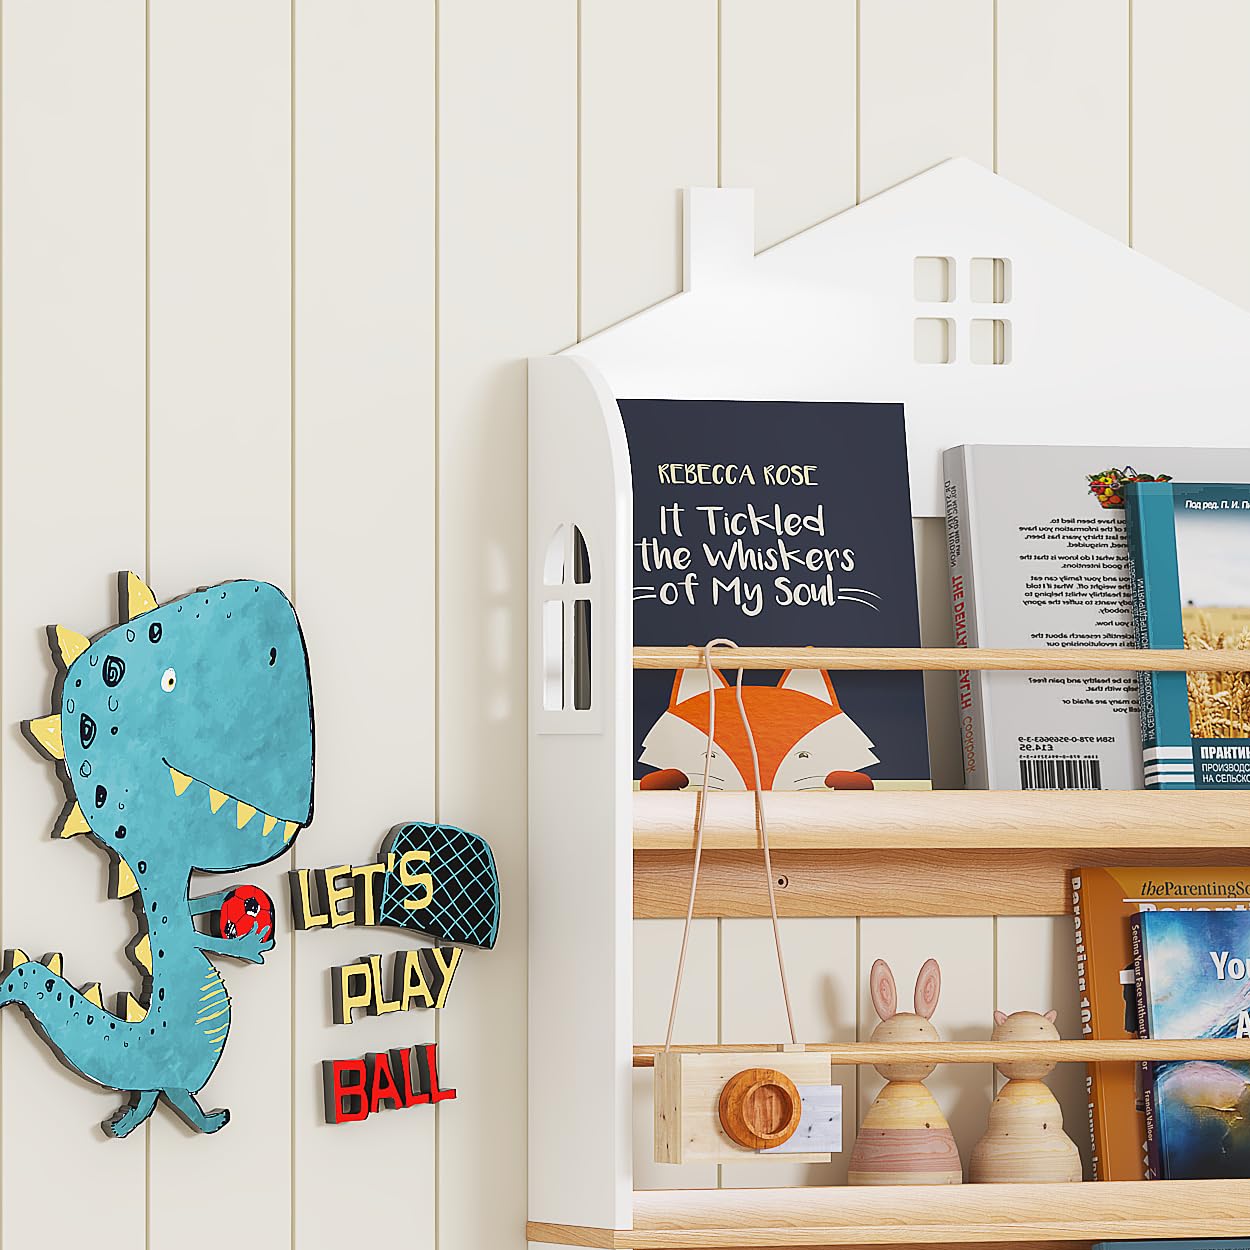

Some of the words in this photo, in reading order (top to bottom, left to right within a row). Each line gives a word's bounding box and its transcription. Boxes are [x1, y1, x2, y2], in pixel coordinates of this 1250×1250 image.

[658, 463, 755, 486] REBECCA
[764, 464, 818, 486] ROSE
[660, 503, 684, 536] It
[696, 503, 826, 536] Tickled
[1184, 500, 1201, 511] Под
[634, 538, 691, 571] the
[703, 538, 855, 571] Whiskers
[659, 573, 699, 606] of
[712, 576, 763, 616] My
[775, 574, 836, 607] Soul
[1202, 773, 1214, 783] НА
[289, 850, 434, 930] LET'S
[1131, 924, 1141, 955] Seeing
[1133, 954, 1142, 976] Your
[331, 947, 463, 1025] PLAY
[1135, 977, 1144, 997] Face
[1137, 998, 1147, 1034] without
[322, 1043, 457, 1124] BALL
[1143, 1090, 1152, 1116] Francis
[1145, 1116, 1154, 1141] Valloor
